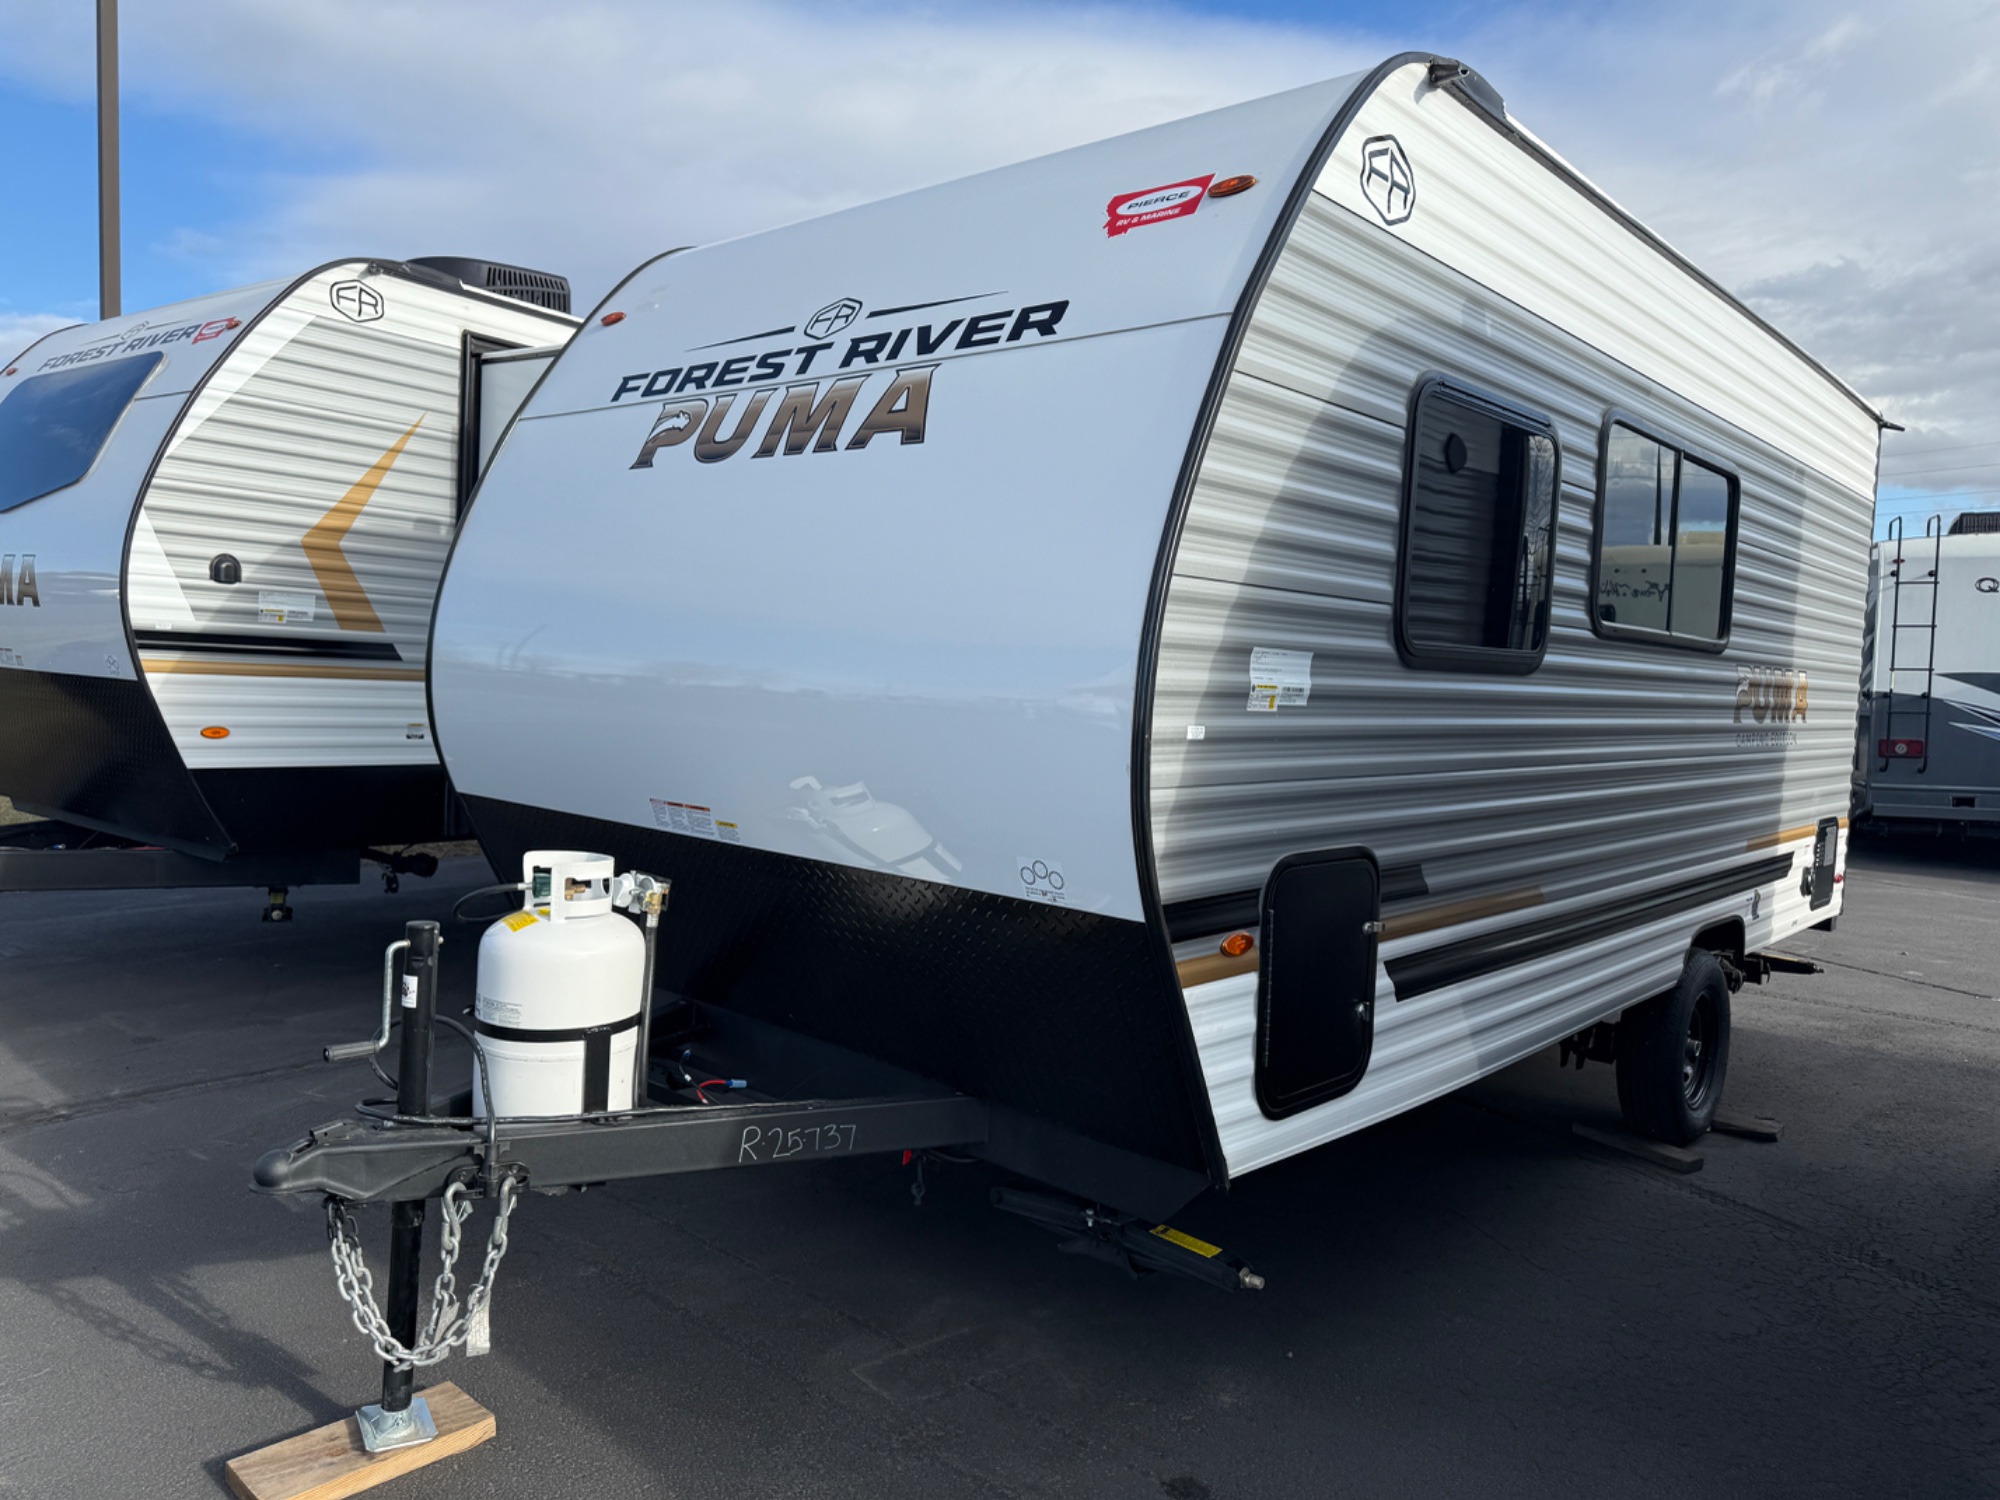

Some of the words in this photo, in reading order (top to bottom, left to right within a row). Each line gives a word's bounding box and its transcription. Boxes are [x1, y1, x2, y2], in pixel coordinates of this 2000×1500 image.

[1115, 217, 1130, 227] RV
[1139, 207, 1181, 222] MARINE
[1127, 190, 1190, 210] PIERCE
[38, 342, 125, 372] FOREST
[122, 323, 202, 352] RIVER
[610, 342, 835, 402] FOREST
[839, 300, 1070, 368] RIVER
[629, 363, 942, 470] PUMA
[1733, 664, 1808, 724] PUMA
